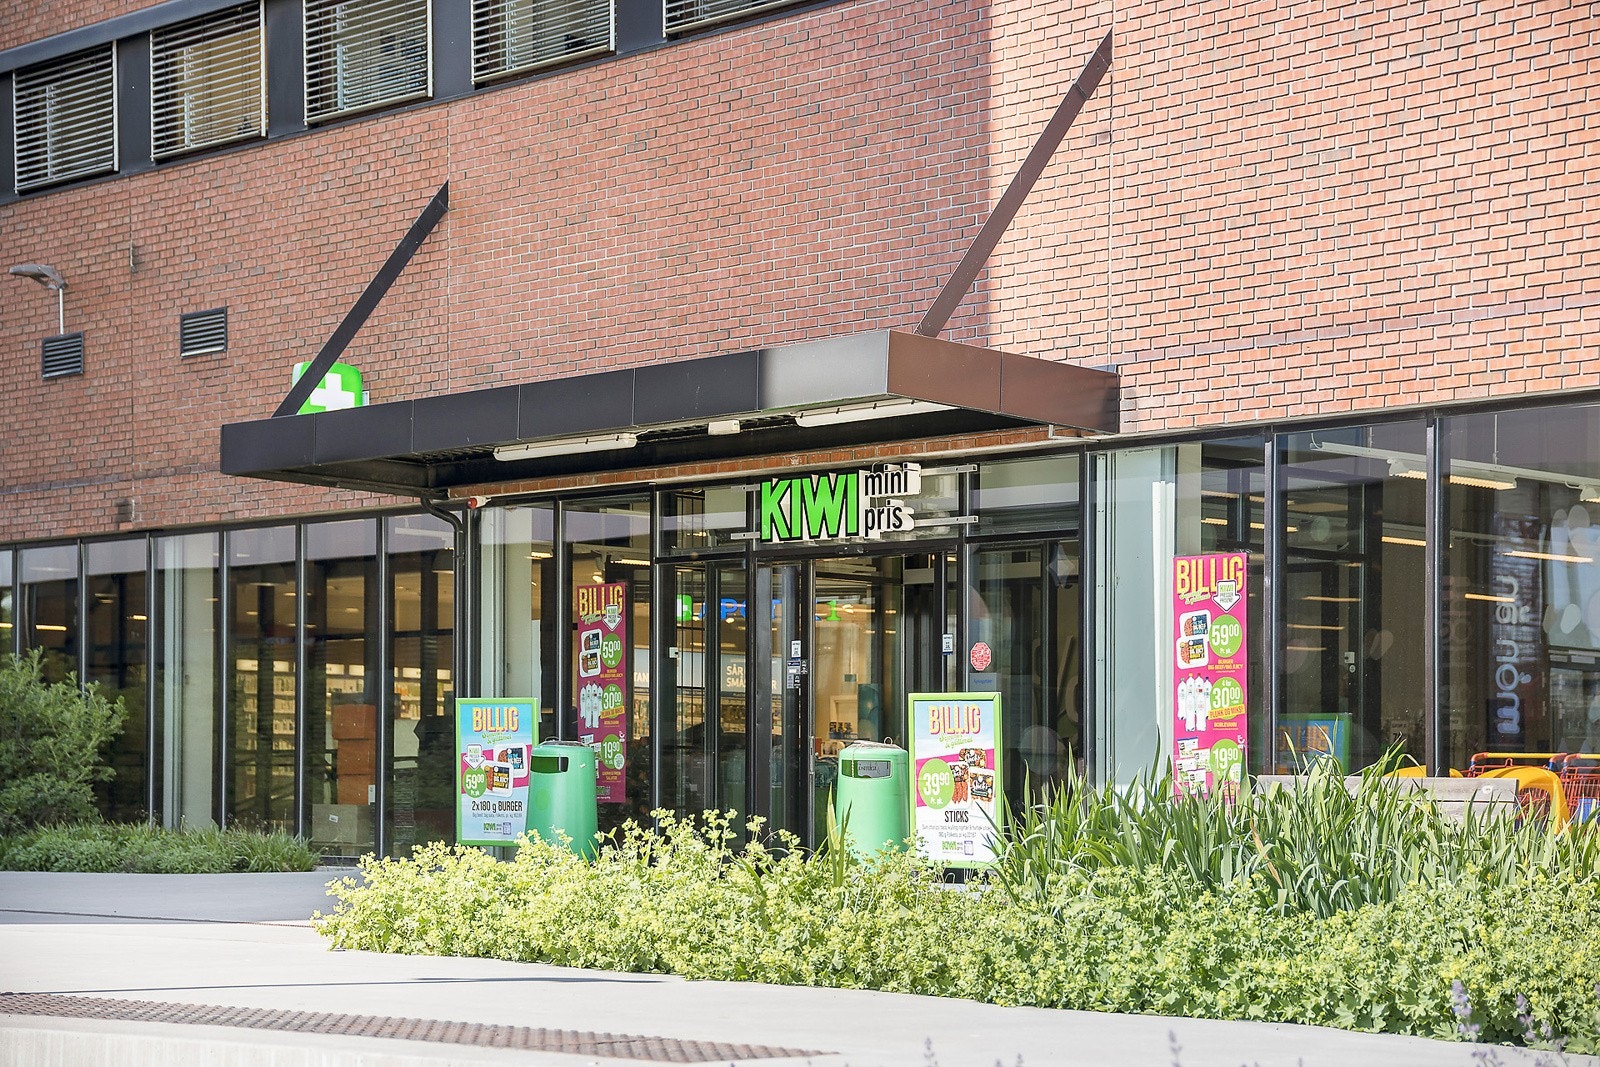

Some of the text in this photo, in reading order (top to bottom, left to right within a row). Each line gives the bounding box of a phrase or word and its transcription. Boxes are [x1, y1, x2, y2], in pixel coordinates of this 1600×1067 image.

[864, 463, 909, 496] mini
[760, 472, 859, 542] KIWI
[864, 499, 903, 538] pris
[1176, 555, 1245, 595] BILLIG
[578, 585, 624, 616] BILLIG
[472, 706, 519, 733] BILLIG
[928, 703, 981, 735] BILLIG
[471, 800, 523, 813] 2x180 g BURGER
[944, 810, 969, 823] STICKS
